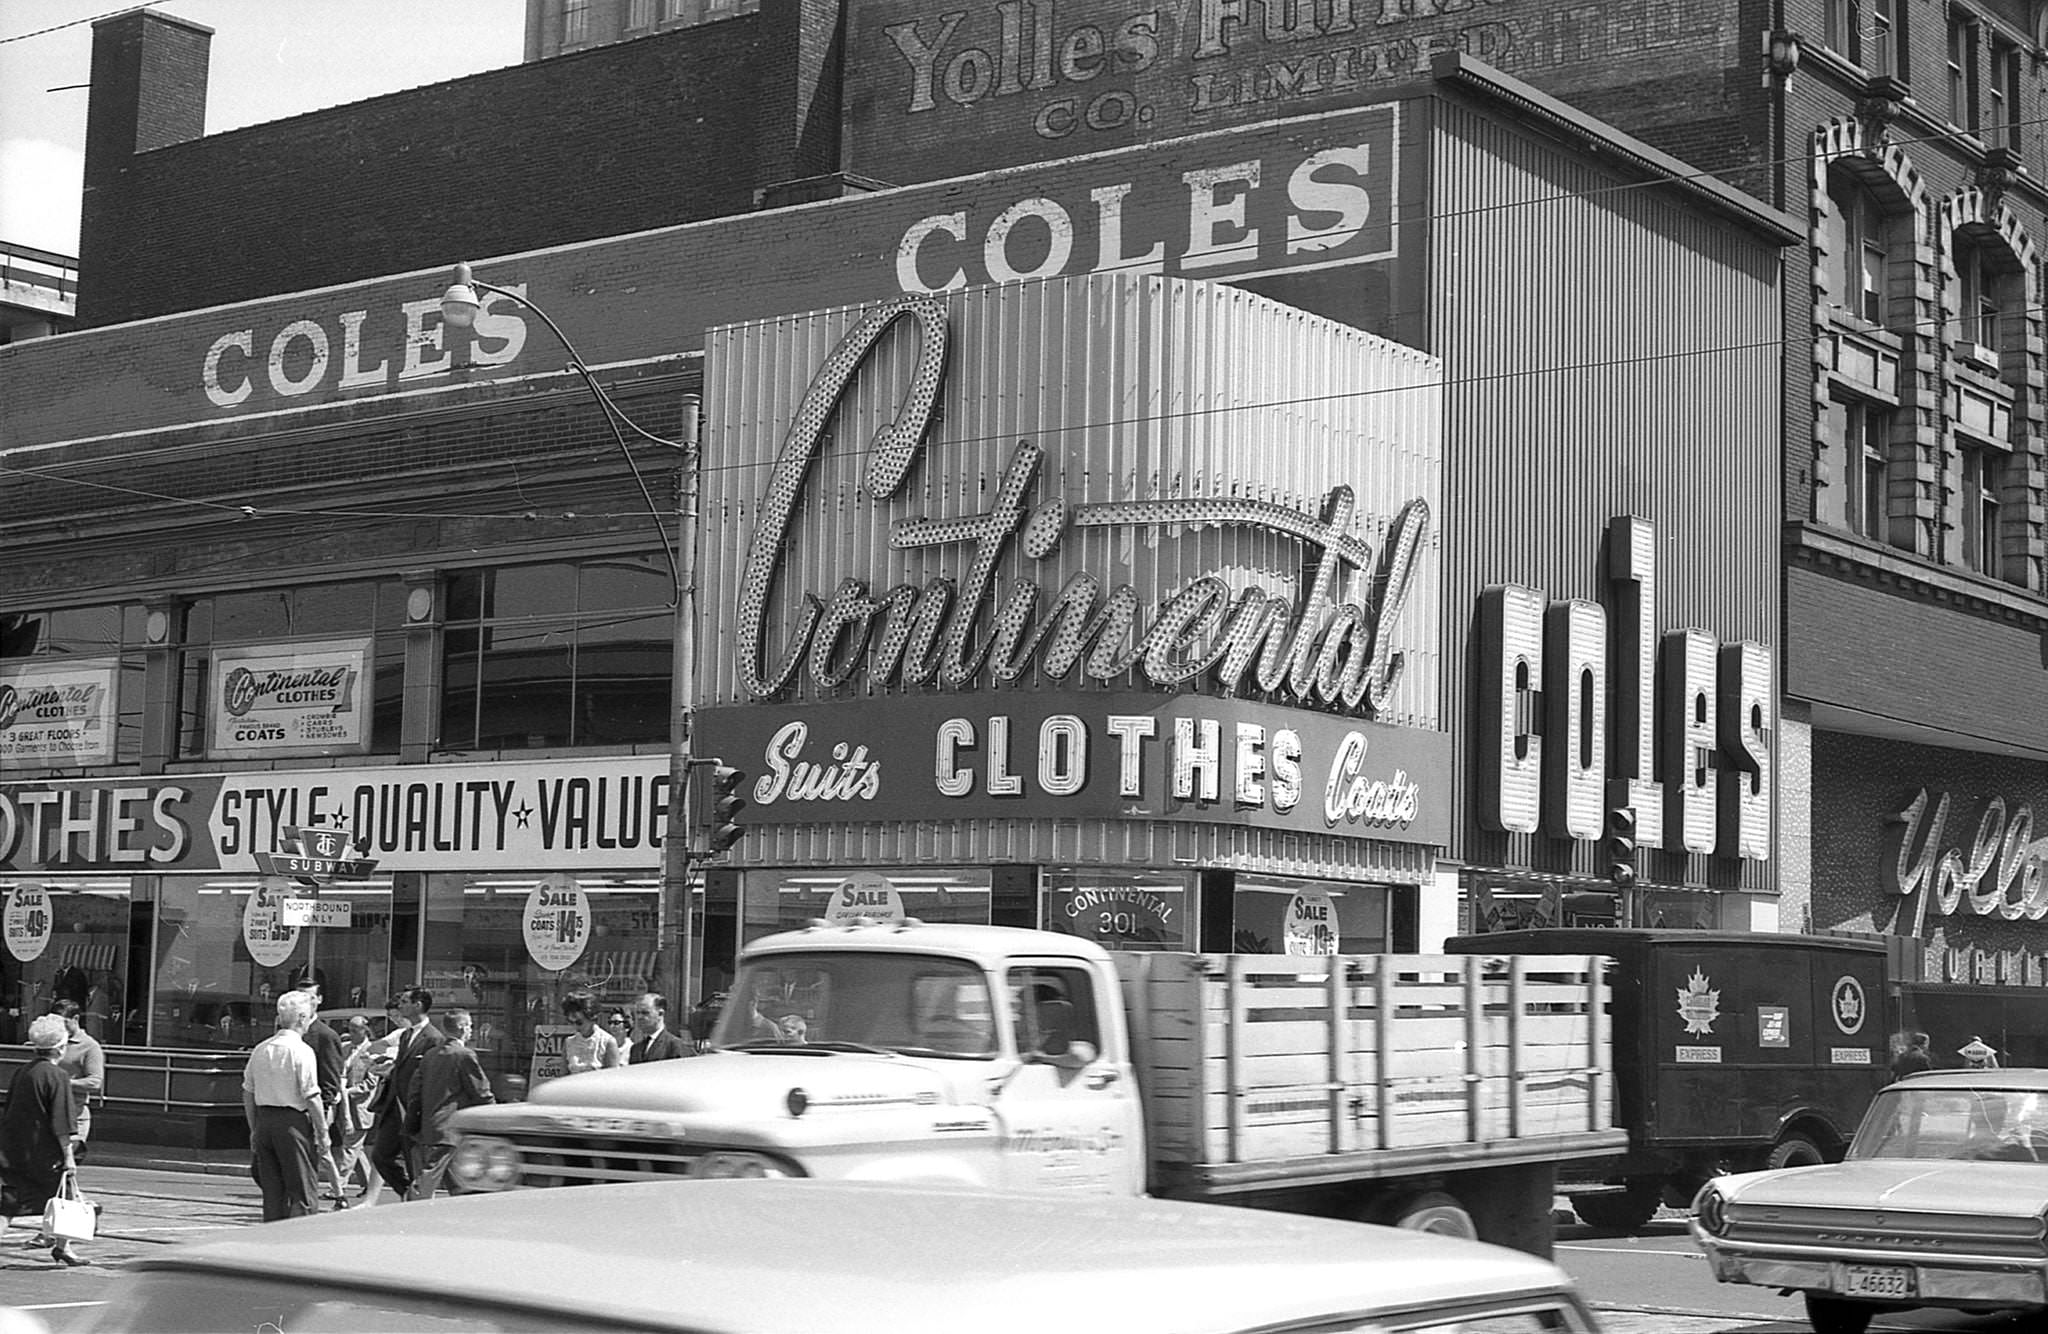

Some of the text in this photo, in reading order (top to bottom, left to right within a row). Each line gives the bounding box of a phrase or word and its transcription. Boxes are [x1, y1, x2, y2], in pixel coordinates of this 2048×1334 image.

[882, 0, 1160, 115] Yolles
[895, 143, 1372, 296] COLES
[202, 283, 529, 408] COLES
[735, 293, 1429, 711] Continental
[231, 667, 347, 710] Continental
[276, 688, 337, 703] CLOTHES
[234, 728, 286, 742] COATS
[754, 714, 1420, 825] Suits CLOTHES Coats
[352, 780, 516, 853] QUALITY
[538, 774, 671, 851] VALUE
[289, 859, 359, 873] SUBWAY
[14, 888, 43, 908] SALE
[539, 884, 577, 906] SALE
[841, 883, 889, 907] SALE
[1065, 887, 1173, 924] CONTINENTAL
[285, 902, 350, 913] NORTHBOUND
[302, 914, 333, 924] ONLY
[1294, 896, 1328, 921] SALE
[530, 919, 555, 931] COATS
[1099, 911, 1136, 934] 301
[1679, 1048, 1719, 1060] EXPRESS
[1834, 1050, 1869, 1062] EXPRESS
